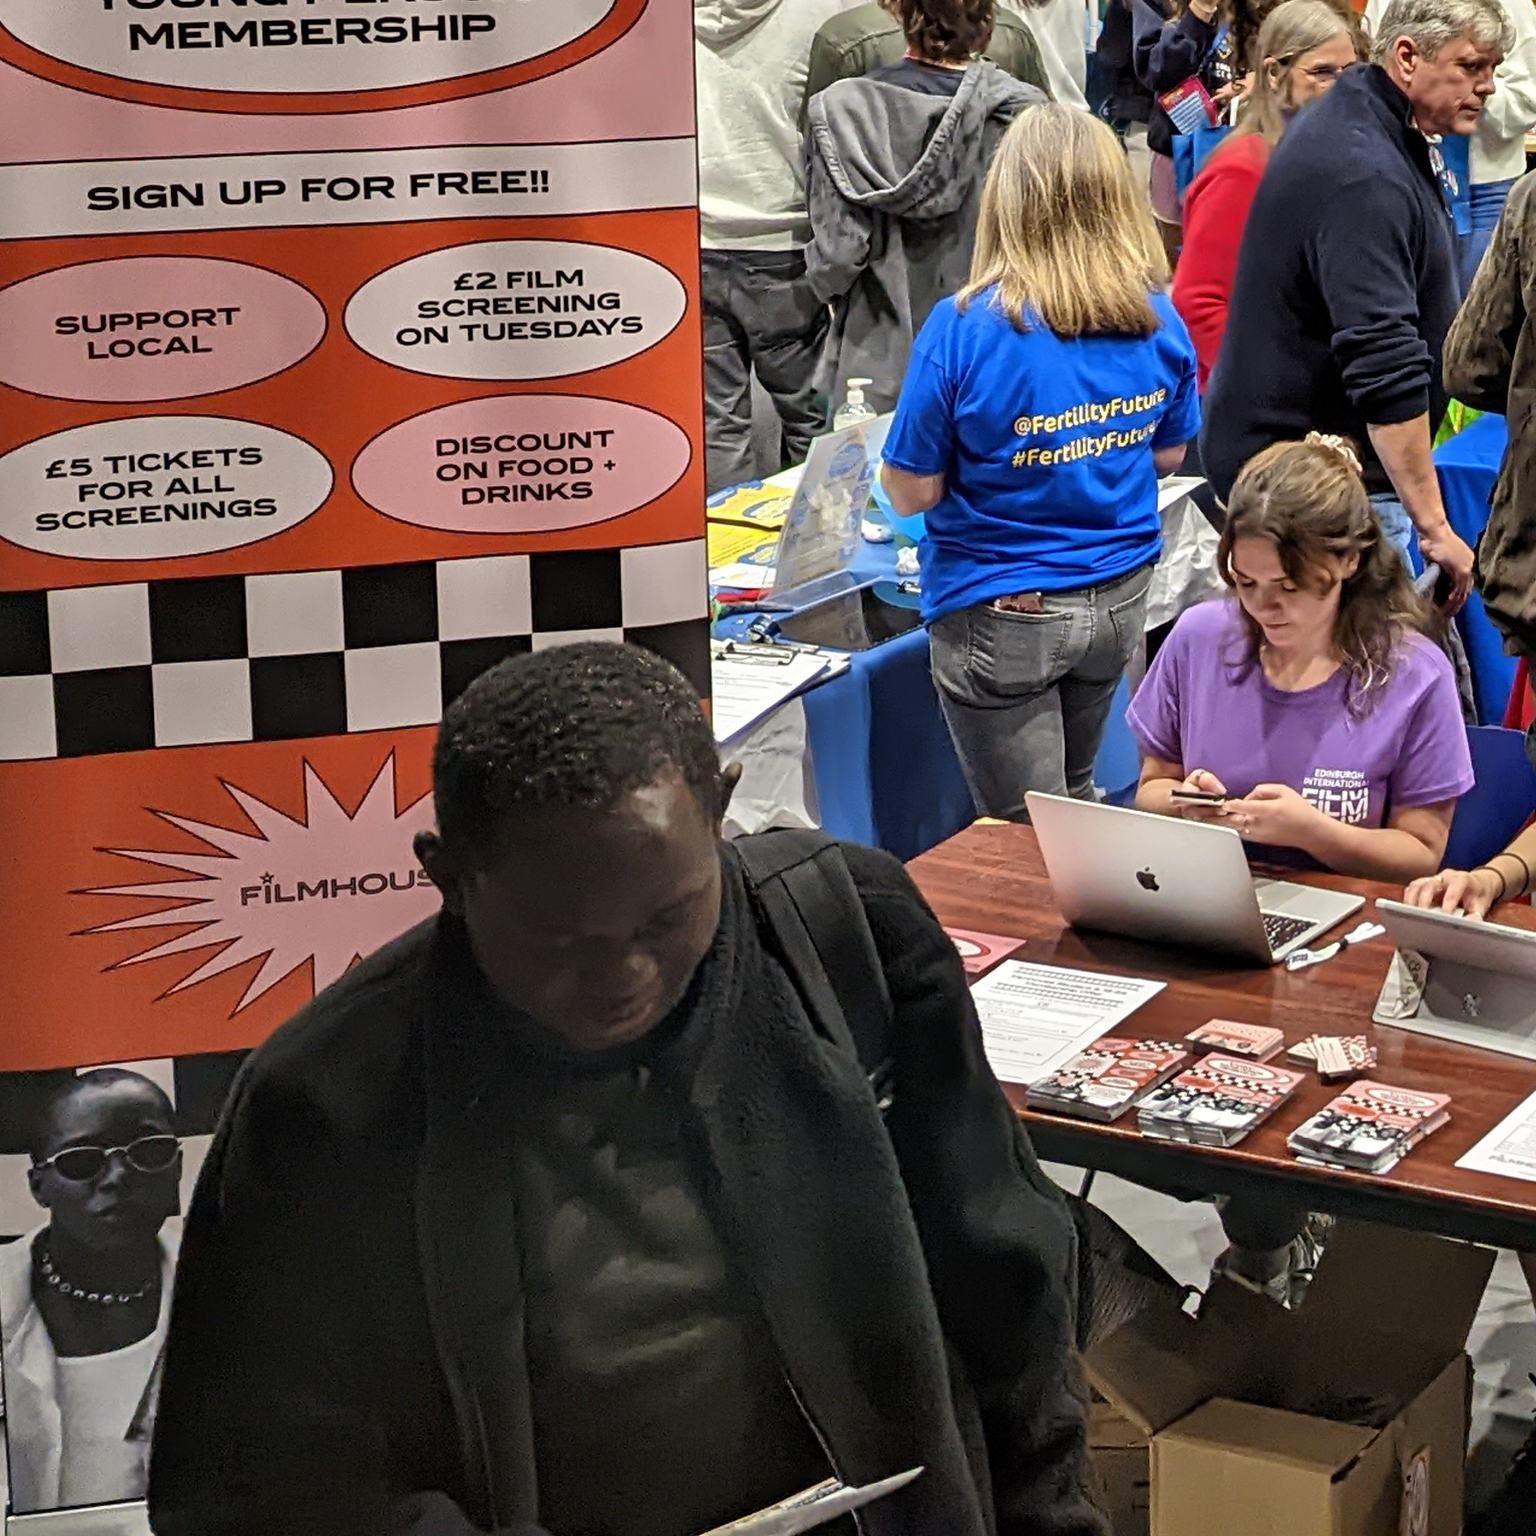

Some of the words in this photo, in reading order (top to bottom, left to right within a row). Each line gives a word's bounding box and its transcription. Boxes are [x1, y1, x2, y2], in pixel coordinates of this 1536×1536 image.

[128, 14, 497, 52] MEMBERSHIP
[86, 183, 204, 211] SIGN
[218, 180, 287, 207] UP
[301, 176, 395, 204] FOR
[409, 169, 549, 198] FREE!!
[453, 272, 497, 291] £2
[506, 269, 585, 290] FILM
[416, 293, 621, 320] SCREENING
[55, 307, 242, 336] SUPPORT
[395, 325, 450, 347] ON
[458, 316, 644, 343] TUESDAYS
[87, 335, 213, 360] LOCAL
[436, 429, 615, 457] DISCOUNT
[45, 459, 92, 480] £5
[103, 447, 264, 475] TICKETS
[436, 460, 490, 483] ON
[498, 456, 594, 479] FOOD
[603, 459, 617, 473] +
[78, 479, 156, 502] FOR
[165, 474, 235, 496] ALL
[461, 481, 594, 506] DRINKS
[35, 497, 278, 532] SCREENINGS
[1315, 769, 1364, 779] EDINBURGH
